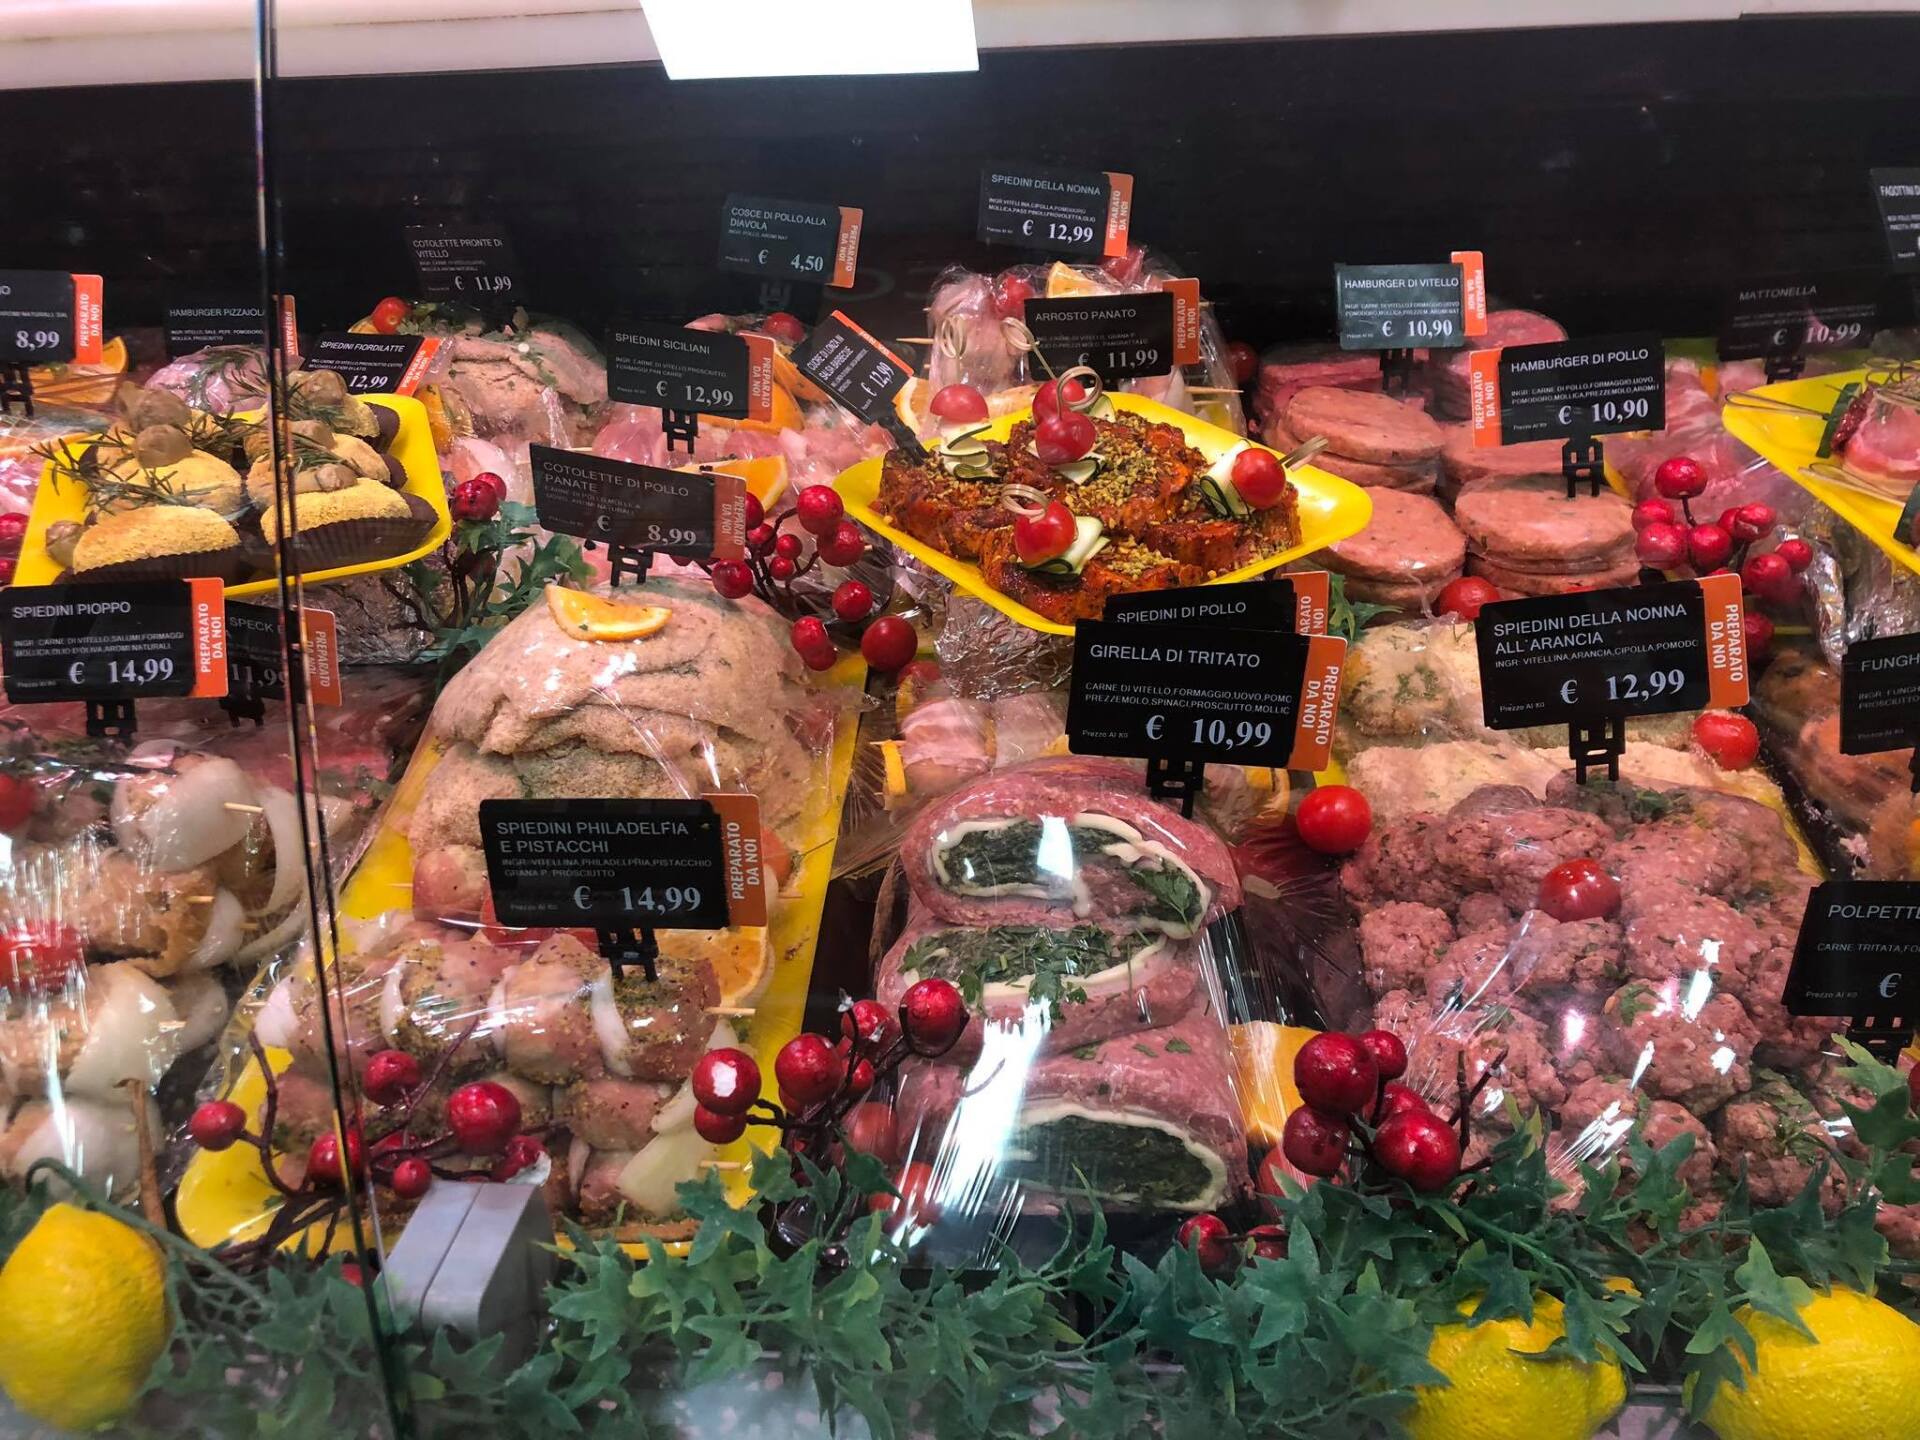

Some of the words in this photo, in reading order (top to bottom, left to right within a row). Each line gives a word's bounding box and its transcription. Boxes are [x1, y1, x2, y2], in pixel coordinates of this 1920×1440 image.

[991, 174, 1033, 188] SPIEDINI
[1034, 179, 1065, 192] DELLA
[1066, 184, 1101, 195] NONNA
[731, 207, 762, 219] COSCE
[763, 211, 773, 220] DI
[774, 213, 804, 224] POLLO
[804, 216, 827, 226] ALLA
[1109, 190, 1121, 240] PREPARATO
[1121, 201, 1129, 218] NOI
[730, 218, 768, 232] DIAVOLA
[1022, 219, 1034, 236] €
[1048, 223, 1093, 244] 12,99
[1119, 218, 1127, 231] DA
[412, 239, 459, 248] COTOLETTE
[460, 239, 493, 247] PRONTE
[493, 238, 503, 247] DI
[416, 249, 449, 258] VITELLO
[845, 224, 859, 272] PREPARATO
[758, 249, 769, 265] €
[790, 253, 824, 272] 4,50
[455, 275, 464, 291] €
[475, 276, 512, 293] 11,99
[1344, 278, 1406, 289] HAMBURGER
[1408, 278, 1417, 288] DI
[1419, 277, 1459, 287] VITELLO
[1739, 285, 1817, 301] MATTONELLA
[80, 293, 90, 348] PREPARATO
[90, 304, 100, 322] NOI
[169, 308, 222, 317] HAMBURGER
[1035, 310, 1089, 321] ARROSTO
[1091, 308, 1137, 319] PANATO
[1188, 307, 1197, 325] NOI
[90, 323, 100, 337] DA
[1177, 298, 1186, 349] PREPARATO
[1187, 327, 1197, 339] DA
[1382, 320, 1393, 337] €
[1407, 319, 1453, 339] 10,90
[16, 330, 60, 352] 8,99
[320, 341, 354, 351] SPIEDINI
[353, 343, 406, 353] FIORDILATTE
[615, 332, 661, 347] SPIEDINI
[663, 338, 710, 355] SICILIANI
[1772, 328, 1788, 346] €
[1107, 349, 1159, 369] 11,99
[1511, 355, 1589, 373] HAMBURGER
[1592, 353, 1605, 364] DI
[1607, 348, 1649, 363] POLLO
[752, 365, 761, 378] DA
[761, 356, 772, 408] PREPARATO
[349, 375, 389, 390] 12,99
[752, 379, 761, 397] NOI
[1484, 381, 1495, 402] NOI
[656, 380, 669, 397] €
[685, 384, 733, 407] 12,99
[1473, 370, 1485, 430] PREPARATO
[1486, 403, 1496, 418] DA
[1558, 405, 1572, 425] €
[1591, 397, 1649, 424] 10,90
[543, 461, 623, 486] COTOLETTE
[626, 477, 641, 489] DI
[644, 480, 689, 497] POLLO
[545, 474, 600, 493] PANATE
[722, 502, 732, 516] DA
[596, 514, 611, 532] €
[648, 524, 697, 546] 8,99
[721, 518, 731, 536] NOI
[734, 495, 745, 546] PREPARATO
[12, 604, 74, 619] SPIEDINI
[77, 601, 131, 616] PIOPPO
[1116, 608, 1178, 623] SPIEDINI
[1181, 606, 1196, 619] DI
[1199, 601, 1247, 617] POLLO
[1313, 608, 1324, 629] NOI
[1493, 616, 1564, 637] SPIEDINI
[1569, 610, 1622, 629] DELLA
[1626, 603, 1687, 622] NONNA
[211, 616, 223, 640] NOI
[229, 616, 274, 633] SPECK
[1710, 621, 1723, 642] DA
[198, 603, 211, 673] PREPARATO
[1495, 631, 1604, 656] ALL'ARANCIA
[1725, 603, 1744, 683] PREPARATO
[212, 644, 224, 660] DA
[315, 630, 331, 688] PREPARATO
[1090, 644, 1161, 662] GIRELLA
[1166, 649, 1183, 663] DI
[1188, 649, 1260, 668] TRITATO
[1711, 644, 1727, 669] NOI
[69, 661, 86, 685] €
[108, 657, 173, 685] 14,99
[1085, 682, 1118, 692] CARNE
[1306, 680, 1321, 700] DA
[1560, 679, 1578, 704] €
[1606, 668, 1685, 702] 12,99
[1301, 702, 1318, 729] NOI
[1315, 665, 1339, 746] PREPARATO
[1145, 714, 1165, 741] €
[1191, 718, 1272, 751] 10,99
[496, 821, 572, 835] SPIEDINI
[576, 821, 689, 836] PHILADELFIA
[500, 841, 511, 853] E
[517, 840, 609, 853] PISTACCHI
[745, 838, 760, 864] NOI
[726, 821, 745, 900] PREPARATO
[504, 869, 539, 877] GRANA
[552, 868, 616, 878] PROSCIUTTO
[746, 867, 761, 886] DA
[573, 885, 593, 910] €
[620, 886, 701, 916] 14,99
[1817, 942, 1856, 952] CARNE
[1879, 972, 1902, 998] €
